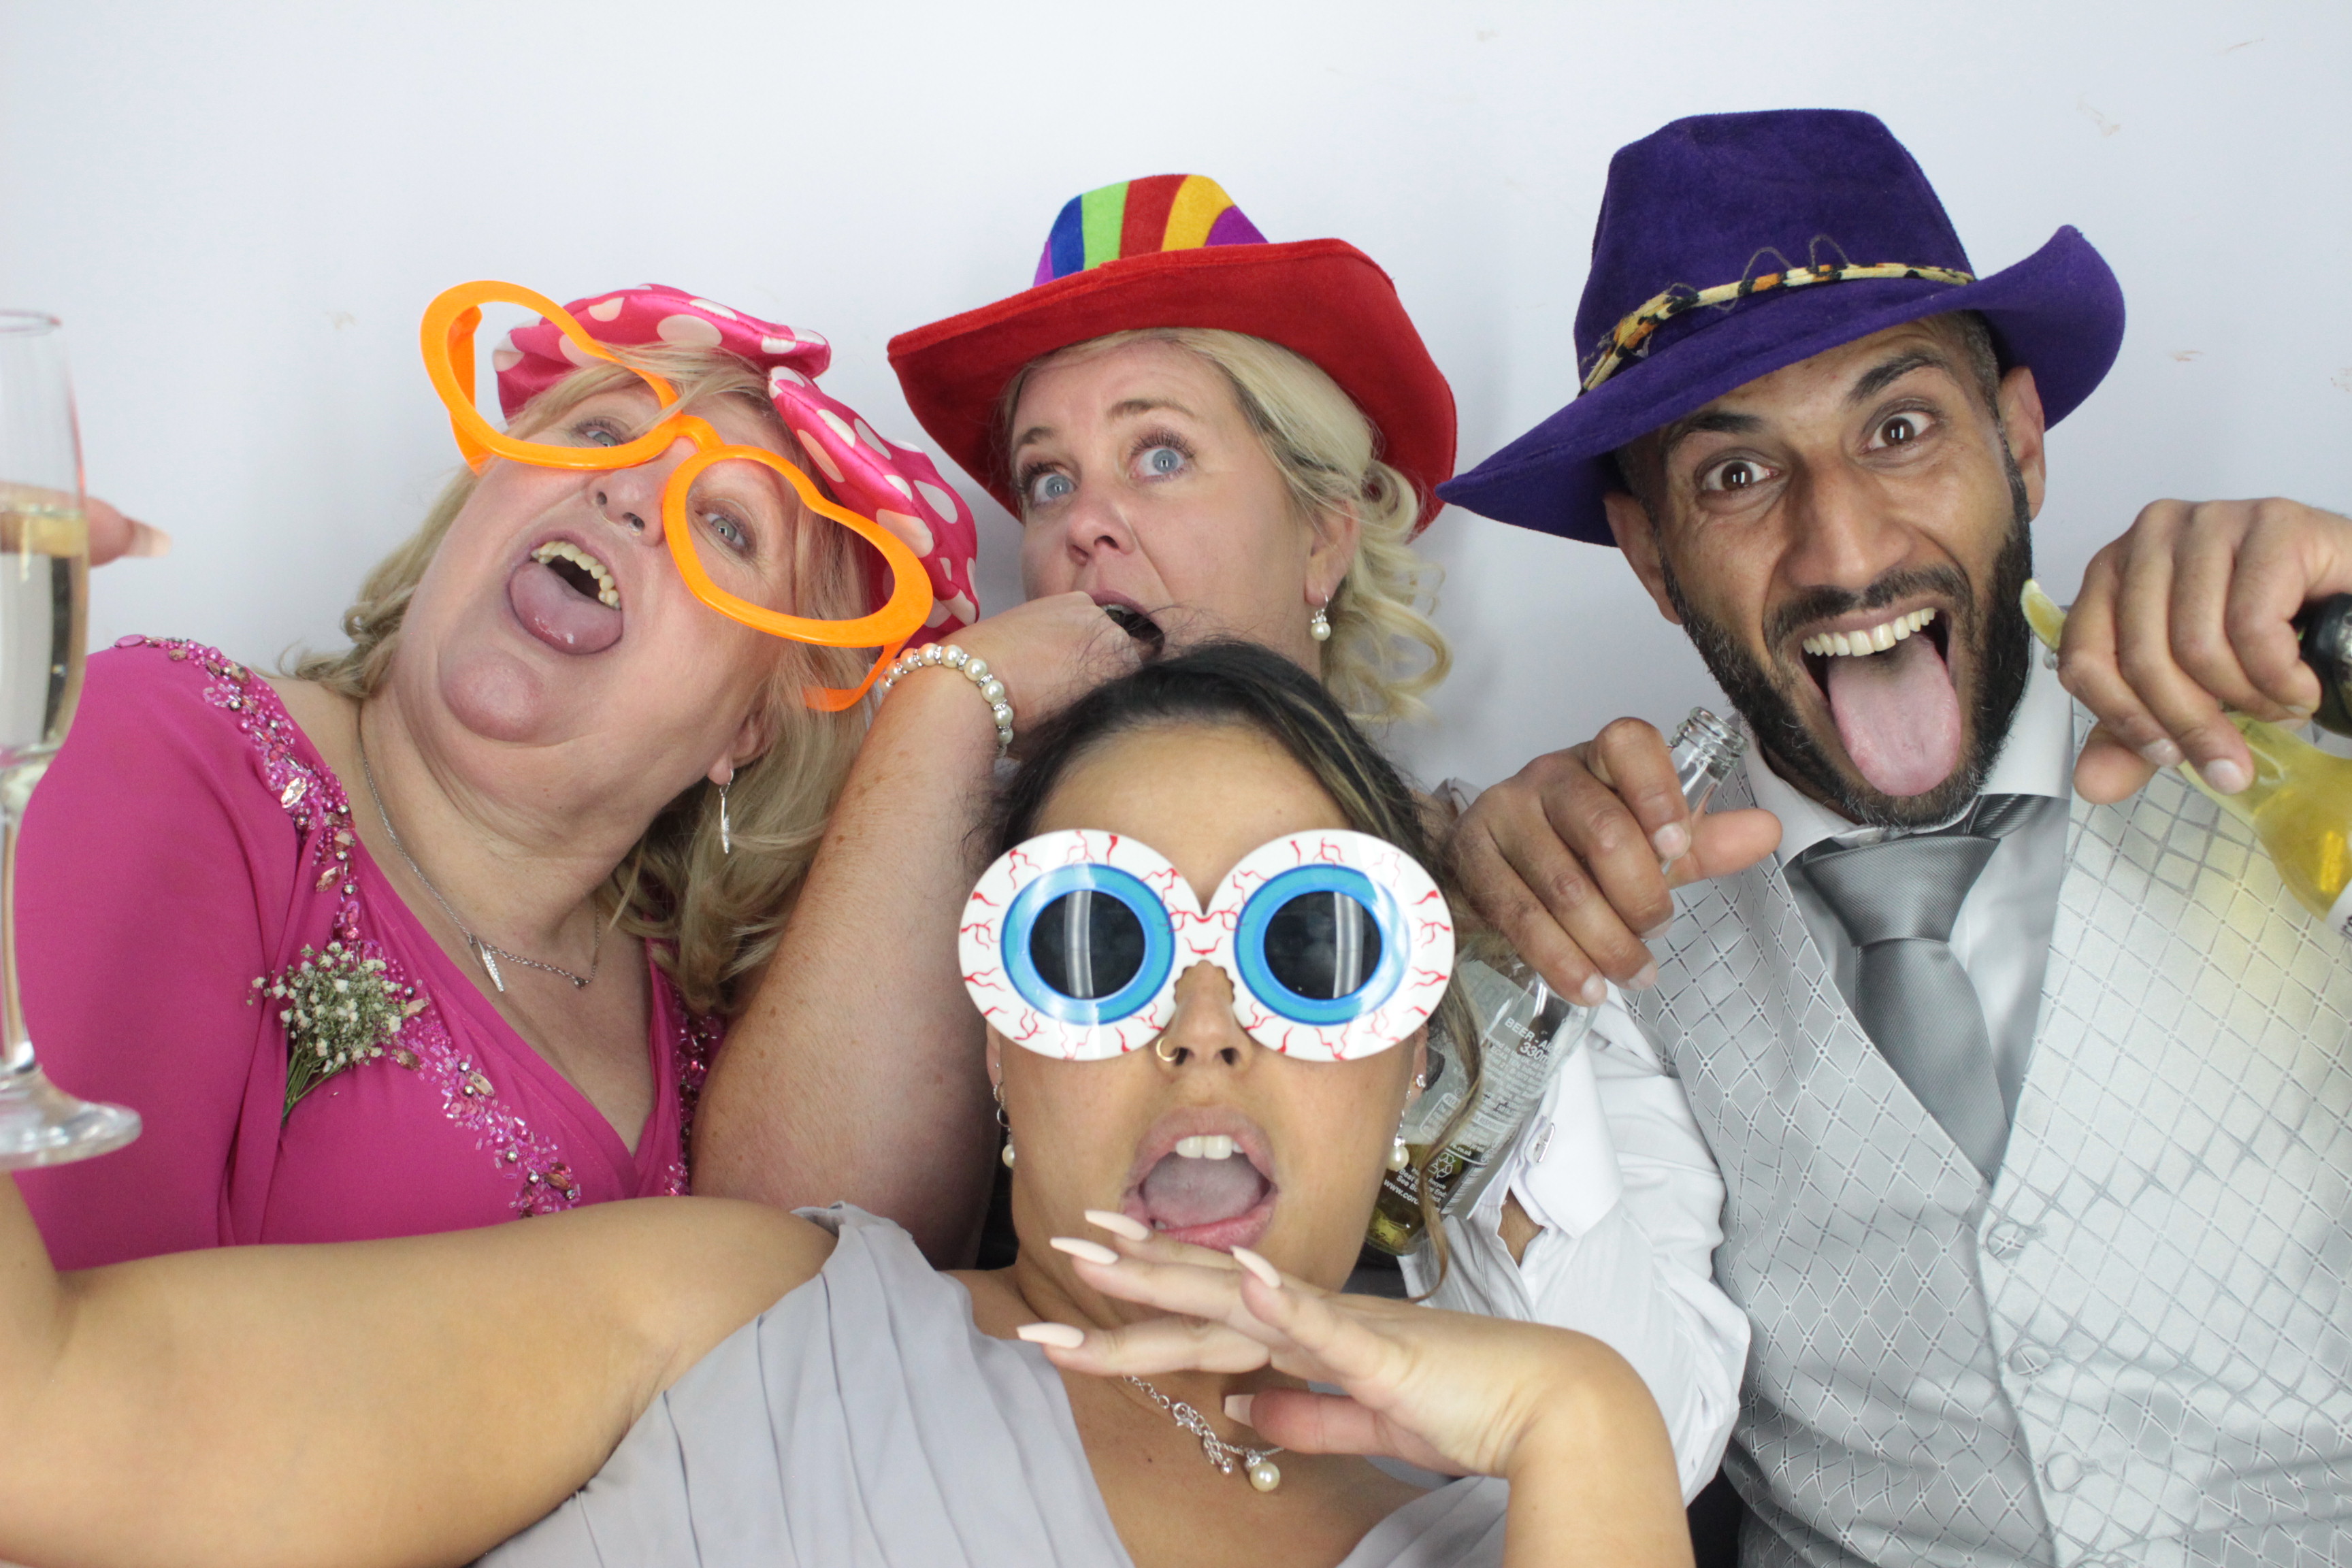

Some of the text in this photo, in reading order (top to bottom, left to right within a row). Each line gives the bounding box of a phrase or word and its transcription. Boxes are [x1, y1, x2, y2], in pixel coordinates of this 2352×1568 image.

[1505, 1017, 1535, 1042] BEER
[1520, 1042, 1550, 1063] 330m
[1396, 1175, 1409, 1186] See
[1399, 1169, 1414, 1181] Best
